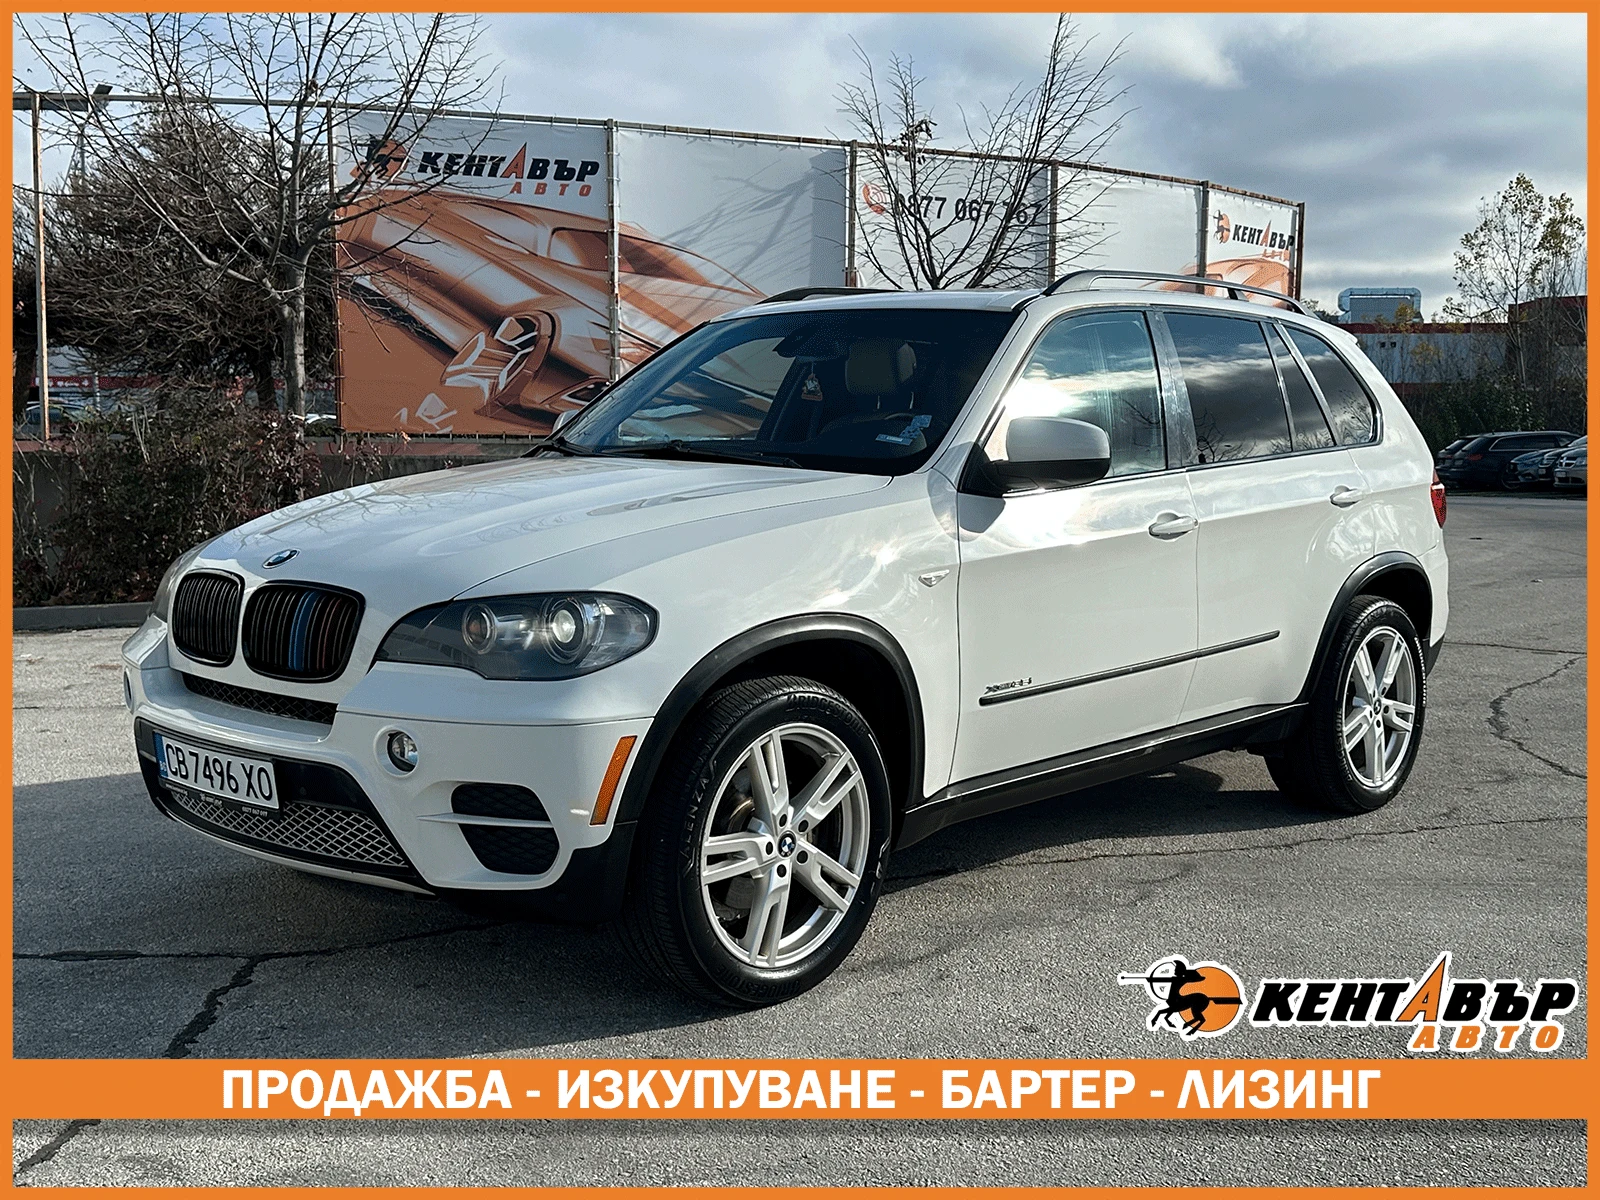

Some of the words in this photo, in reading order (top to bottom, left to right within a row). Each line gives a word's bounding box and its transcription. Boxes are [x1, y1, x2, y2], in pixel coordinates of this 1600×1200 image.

[418, 142, 600, 182] КЕНТАВЪР
[509, 181, 592, 197] АВТО
[954, 198, 994, 221] 067
[1232, 220, 1295, 251] КЕНТАВЪР
